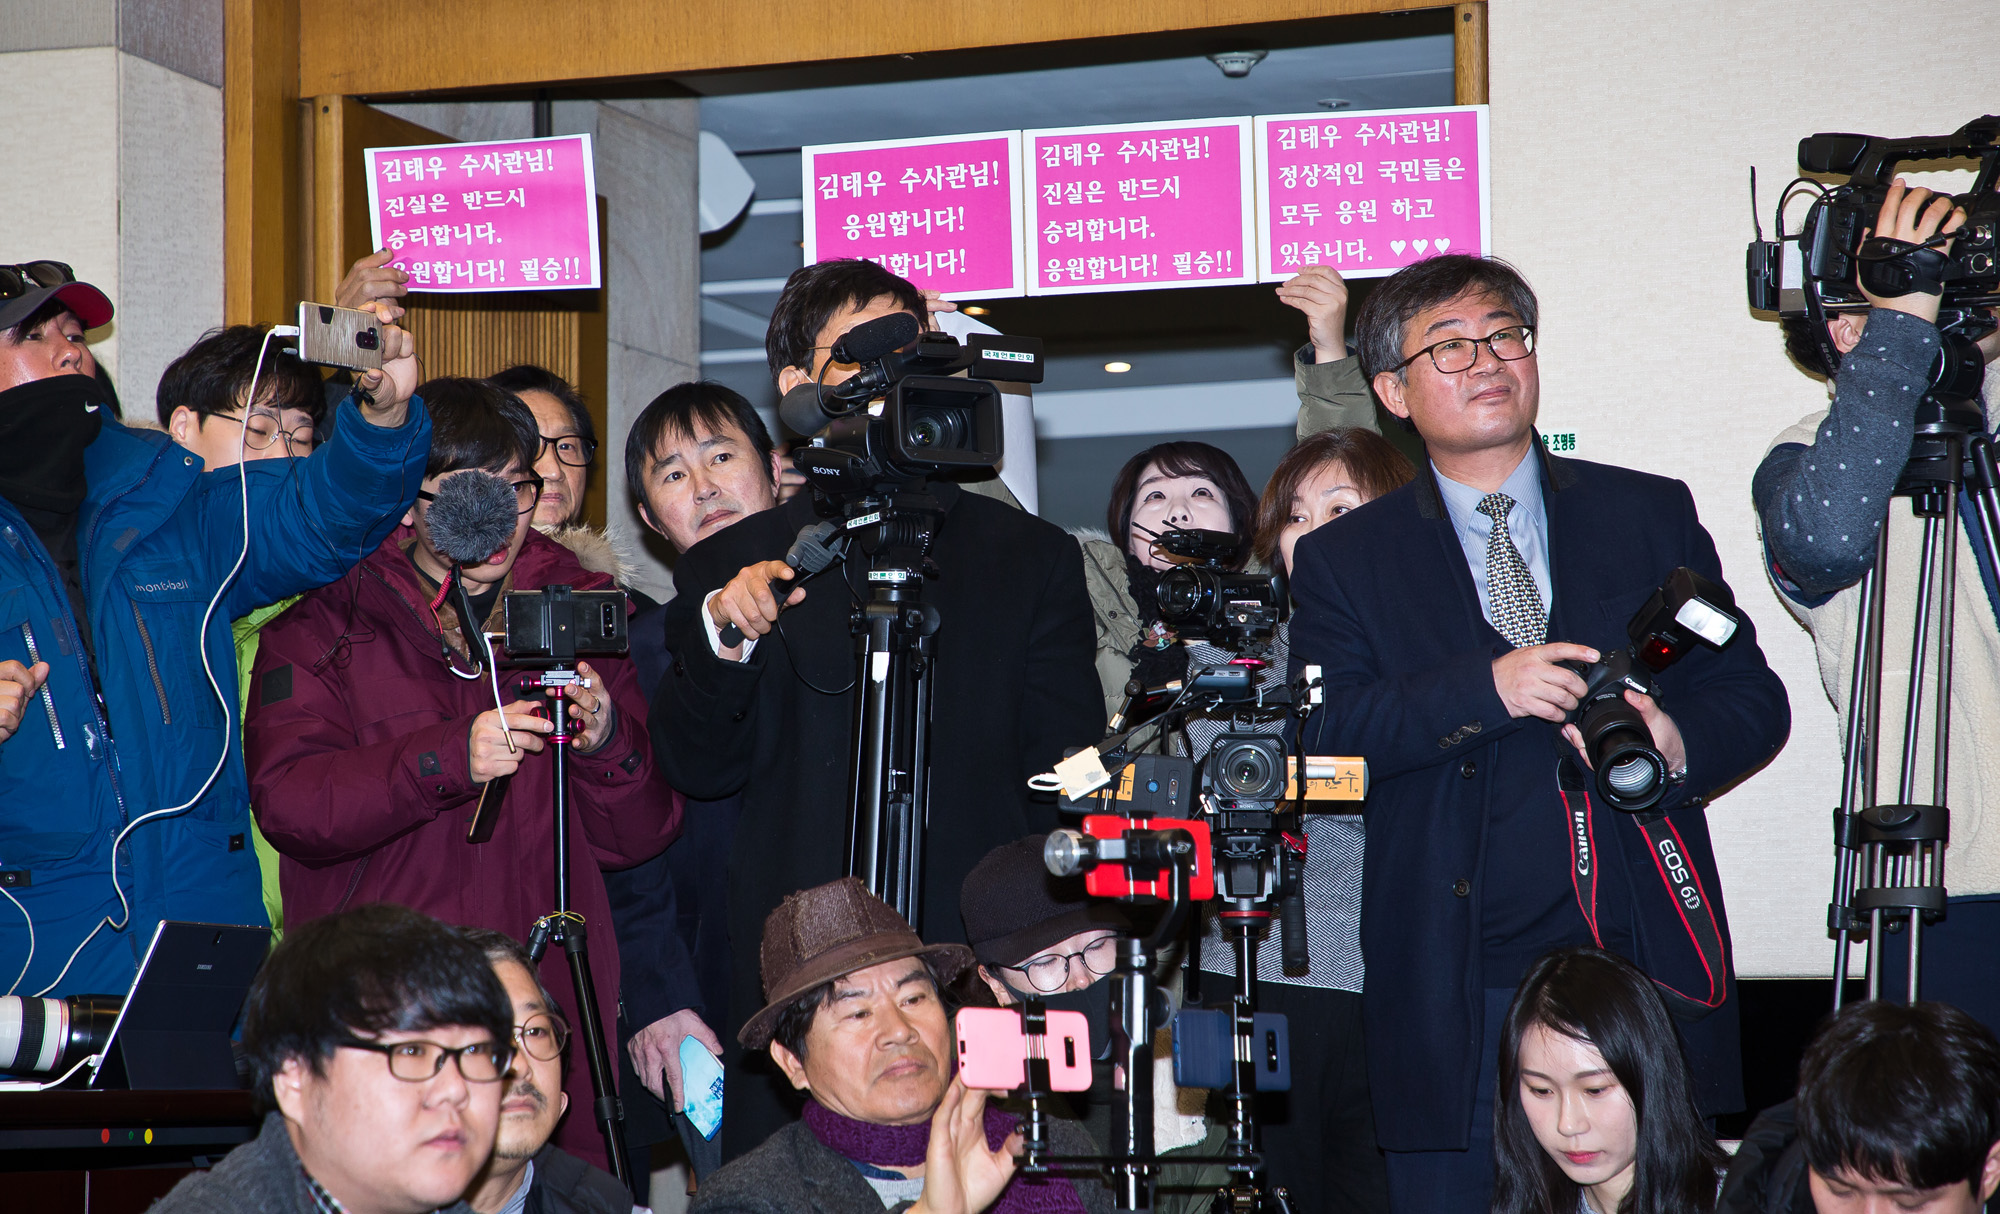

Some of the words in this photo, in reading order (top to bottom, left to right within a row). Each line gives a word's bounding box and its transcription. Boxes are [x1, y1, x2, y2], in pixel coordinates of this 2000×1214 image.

[1277, 125, 1342, 150] 김태우
[1355, 119, 1450, 146] 수사관님!
[382, 157, 447, 182] 김태우
[459, 149, 553, 177] 수사관님!
[1042, 143, 1104, 167] 김태우
[1117, 136, 1209, 163] 수사관님!
[818, 171, 886, 199] 김태우
[900, 161, 998, 193] 수사관님!
[1279, 162, 1363, 188] 정상적인
[1378, 157, 1465, 183] 국민들은
[386, 194, 449, 217] 진실은
[462, 188, 525, 210] 반드시
[1043, 181, 1105, 205] 진실은
[1118, 176, 1179, 201] 반드시
[842, 206, 964, 240] 응원합니다!
[1280, 204, 1322, 226] 모두
[1335, 200, 1377, 224] 응원
[1391, 198, 1435, 221] 하고
[387, 222, 502, 249] 승리합니다.
[1043, 216, 1155, 244] 승리합니다.
[856, 249, 965, 278] 합니다!
[1044, 254, 1158, 282] 응원합니다!
[1173, 250, 1231, 275] 필승!!
[1280, 239, 1372, 266] 있습니다.
[520, 257, 579, 281] 필승!!
[1552, 433, 1576, 451] 조명등
[812, 466, 840, 476] SONY
[1575, 811, 1589, 876] Canon
[1659, 839, 1689, 884] EOS
[1680, 886, 1700, 910] 6D
